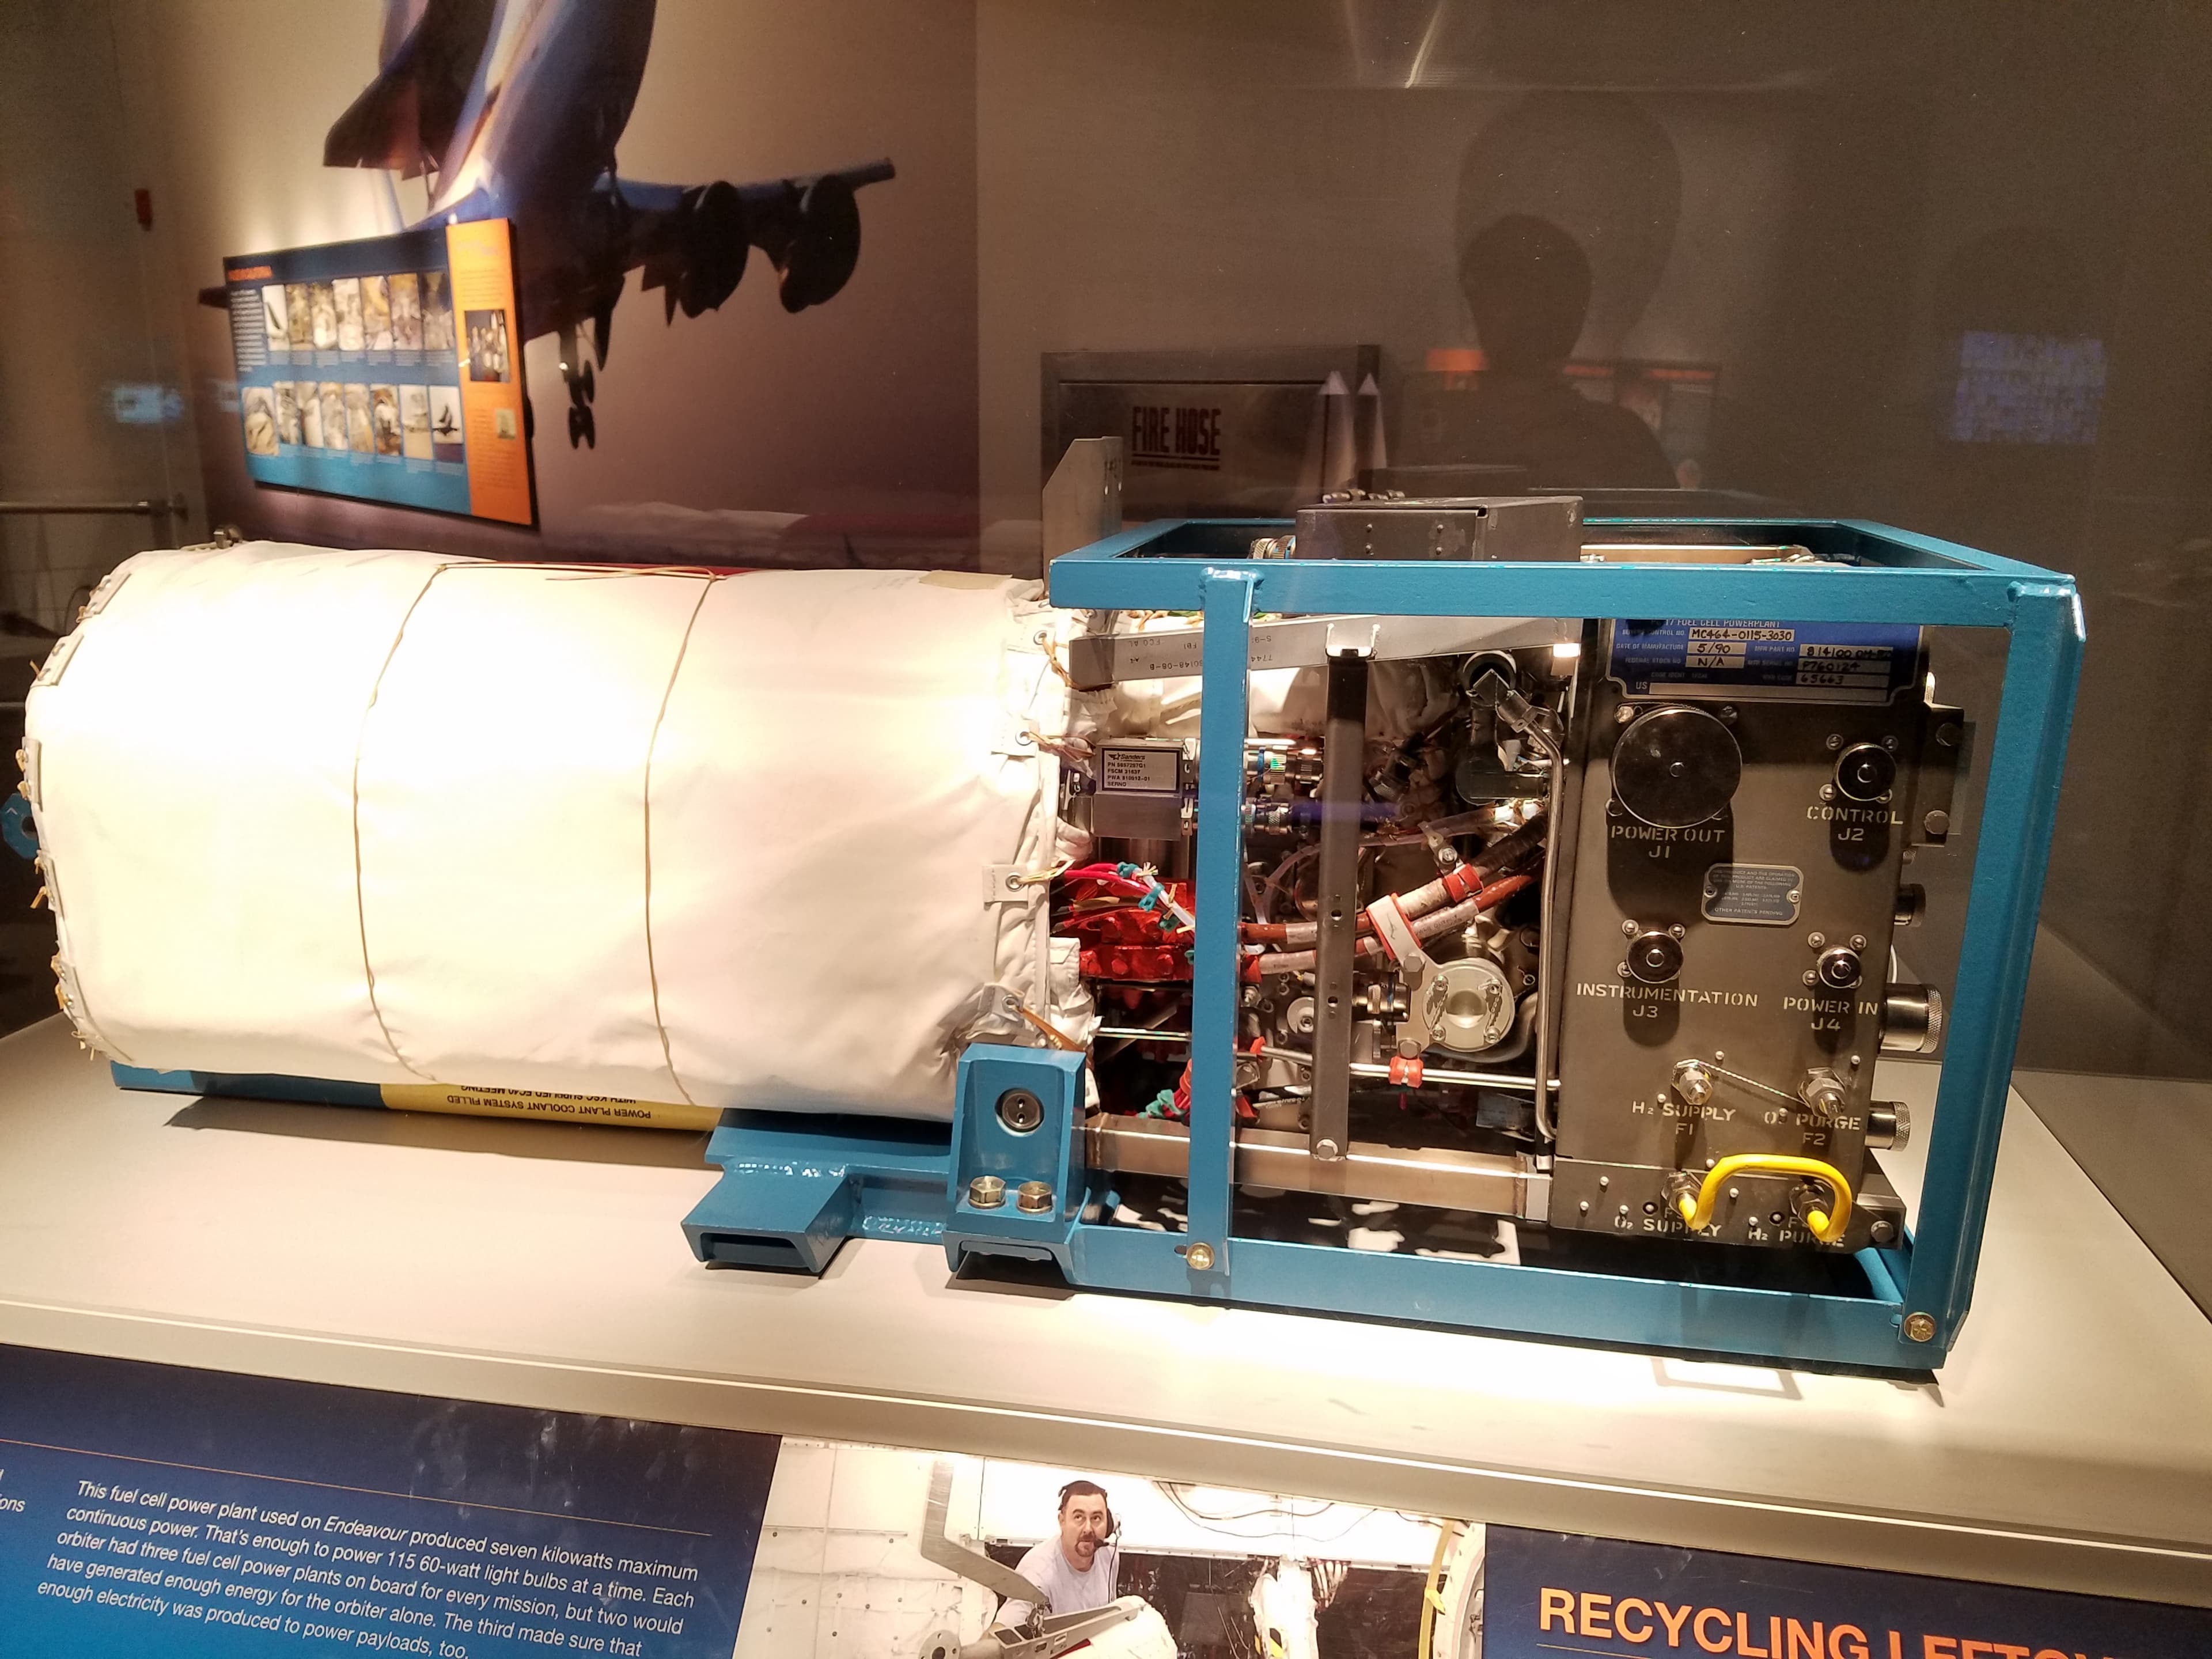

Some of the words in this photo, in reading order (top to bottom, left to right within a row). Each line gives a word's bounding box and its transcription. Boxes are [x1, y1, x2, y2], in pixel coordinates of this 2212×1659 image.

[1132, 407, 1170, 453] FIRE
[1175, 408, 1221, 455] HOSE
[1691, 628, 1791, 641] MC464-0115-3030
[1697, 642, 1731, 653] 5/90
[1698, 656, 1724, 668] N/A
[1635, 682, 1647, 690] US
[1806, 806, 1903, 825] CONTROL
[1611, 825, 1677, 842] POWER
[1684, 828, 1725, 843] OUT
[1838, 827, 1865, 842] J2
[1649, 846, 1670, 859] J1
[1576, 983, 1758, 1007] INSTRUMENTATION
[1633, 1005, 1658, 1019] J3
[1783, 997, 1850, 1014] POWER
[1858, 1000, 1879, 1016] IN
[1810, 1017, 1841, 1031] J4
[446, 1095, 480, 1106] FILLED
[484, 1098, 524, 1109] SYSTEM
[527, 1102, 575, 1113] COOLANT
[578, 1105, 611, 1116] PLANT
[614, 1108, 651, 1119] POWER
[1632, 1101, 1654, 1115] H2
[1662, 1103, 1736, 1122] SUPPLY
[1675, 1122, 1694, 1136] F1
[1796, 1113, 1861, 1131] PURGE
[1802, 1132, 1826, 1146] F2
[1643, 1218, 1722, 1237] SUPLY
[1779, 1230, 1846, 1248] PURE
[0, 1494, 26, 1513] ons
[78, 1480, 107, 1499] This
[109, 1485, 140, 1503] fuel
[139, 1492, 168, 1508] cell
[166, 1497, 218, 1515] power
[217, 1502, 258, 1521] plant
[260, 1510, 300, 1527] used
[301, 1516, 321, 1530] on
[323, 1516, 409, 1541] Endeavour
[408, 1531, 488, 1553] produced
[490, 1541, 537, 1560] seven
[541, 1544, 613, 1570] kilowatts
[617, 1559, 698, 1581] maximum
[66, 1508, 147, 1532] continuous
[148, 1520, 199, 1539] power.
[252, 1535, 310, 1558] enough
[313, 1540, 330, 1558] to
[331, 1547, 385, 1565] power
[388, 1551, 418, 1570] 115
[419, 1555, 482, 1579] 60-watt
[484, 1564, 520, 1586] light
[522, 1569, 568, 1591] bulbs
[571, 1578, 589, 1594] at
[592, 1582, 603, 1597] a
[607, 1581, 646, 1602] time.
[652, 1586, 694, 1608] Each
[56, 1531, 107, 1550] orbiter
[107, 1536, 139, 1555] had
[140, 1541, 179, 1562] three
[181, 1547, 211, 1566] fuel
[212, 1554, 241, 1571] cell
[240, 1560, 293, 1578] power
[293, 1565, 342, 1586] plants
[345, 1575, 366, 1590] on
[369, 1574, 418, 1597] board
[420, 1582, 444, 1600] for
[446, 1589, 491, 1611] every
[493, 1594, 559, 1620] mission,
[565, 1602, 593, 1622] but
[597, 1608, 628, 1627] two
[633, 1615, 684, 1635] would
[47, 1553, 84, 1573] have
[85, 1563, 164, 1585] generated
[164, 1575, 222, 1597] enough
[224, 1584, 278, 1607] energy
[280, 1588, 304, 1607] for
[306, 1593, 331, 1611] the
[334, 1599, 388, 1619] orbiter
[389, 1606, 436, 1627] alone.
[444, 1612, 473, 1632] The
[477, 1618, 516, 1639] third
[517, 1627, 565, 1646] made
[568, 1634, 605, 1652] sure
[609, 1637, 642, 1657] that
[37, 1582, 93, 1604] enough
[96, 1588, 170, 1617] electricity
[172, 1603, 203, 1619] was
[204, 1608, 282, 1631] produced
[284, 1617, 300, 1634] to
[302, 1623, 355, 1642] power
[355, 1631, 433, 1657] payloads,
[439, 1640, 468, 1659] too.
[1540, 1587, 1869, 1659] RECYCLING
